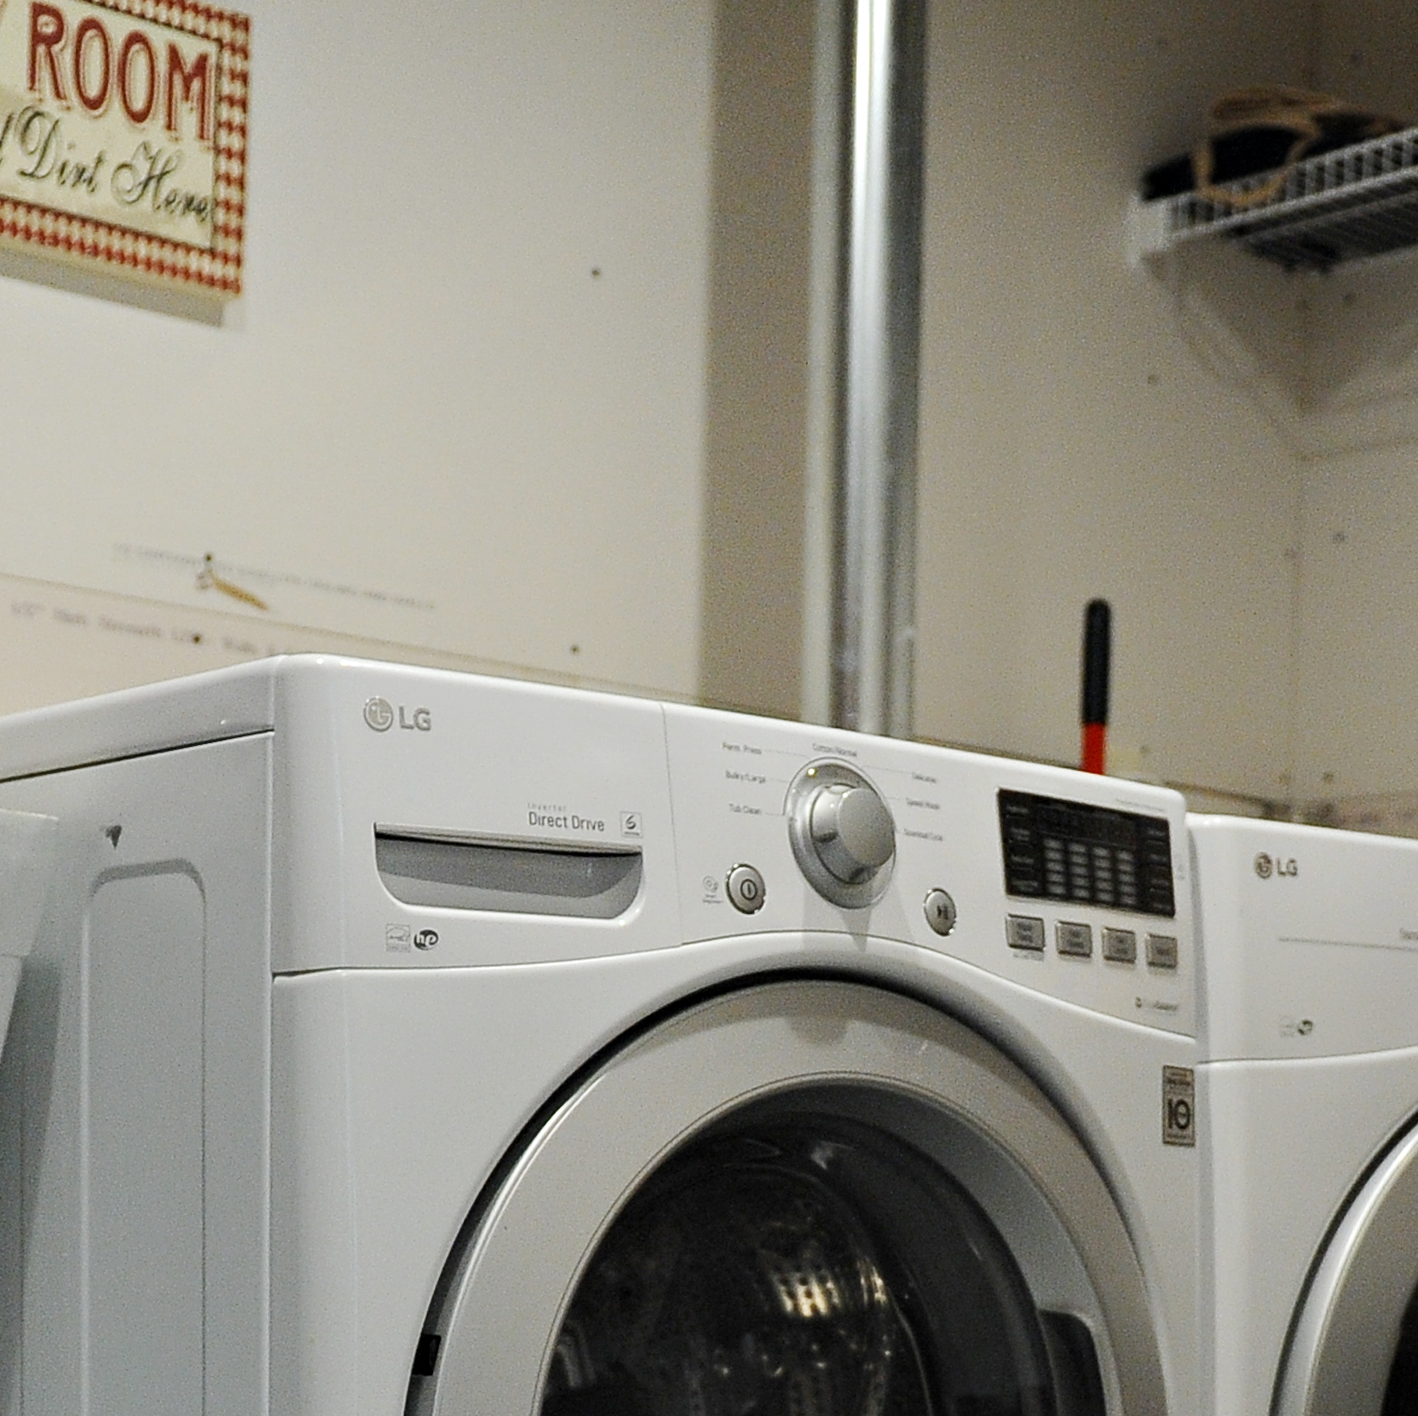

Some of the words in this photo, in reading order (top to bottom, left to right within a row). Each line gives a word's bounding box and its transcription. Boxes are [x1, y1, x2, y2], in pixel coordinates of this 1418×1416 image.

[28, 0, 214, 141] ROOM
[15, 105, 108, 194] Dirt
[398, 706, 431, 731] LG
[528, 811, 568, 829] Direct
[571, 815, 605, 832] Drive
[1277, 857, 1298, 877] LG
